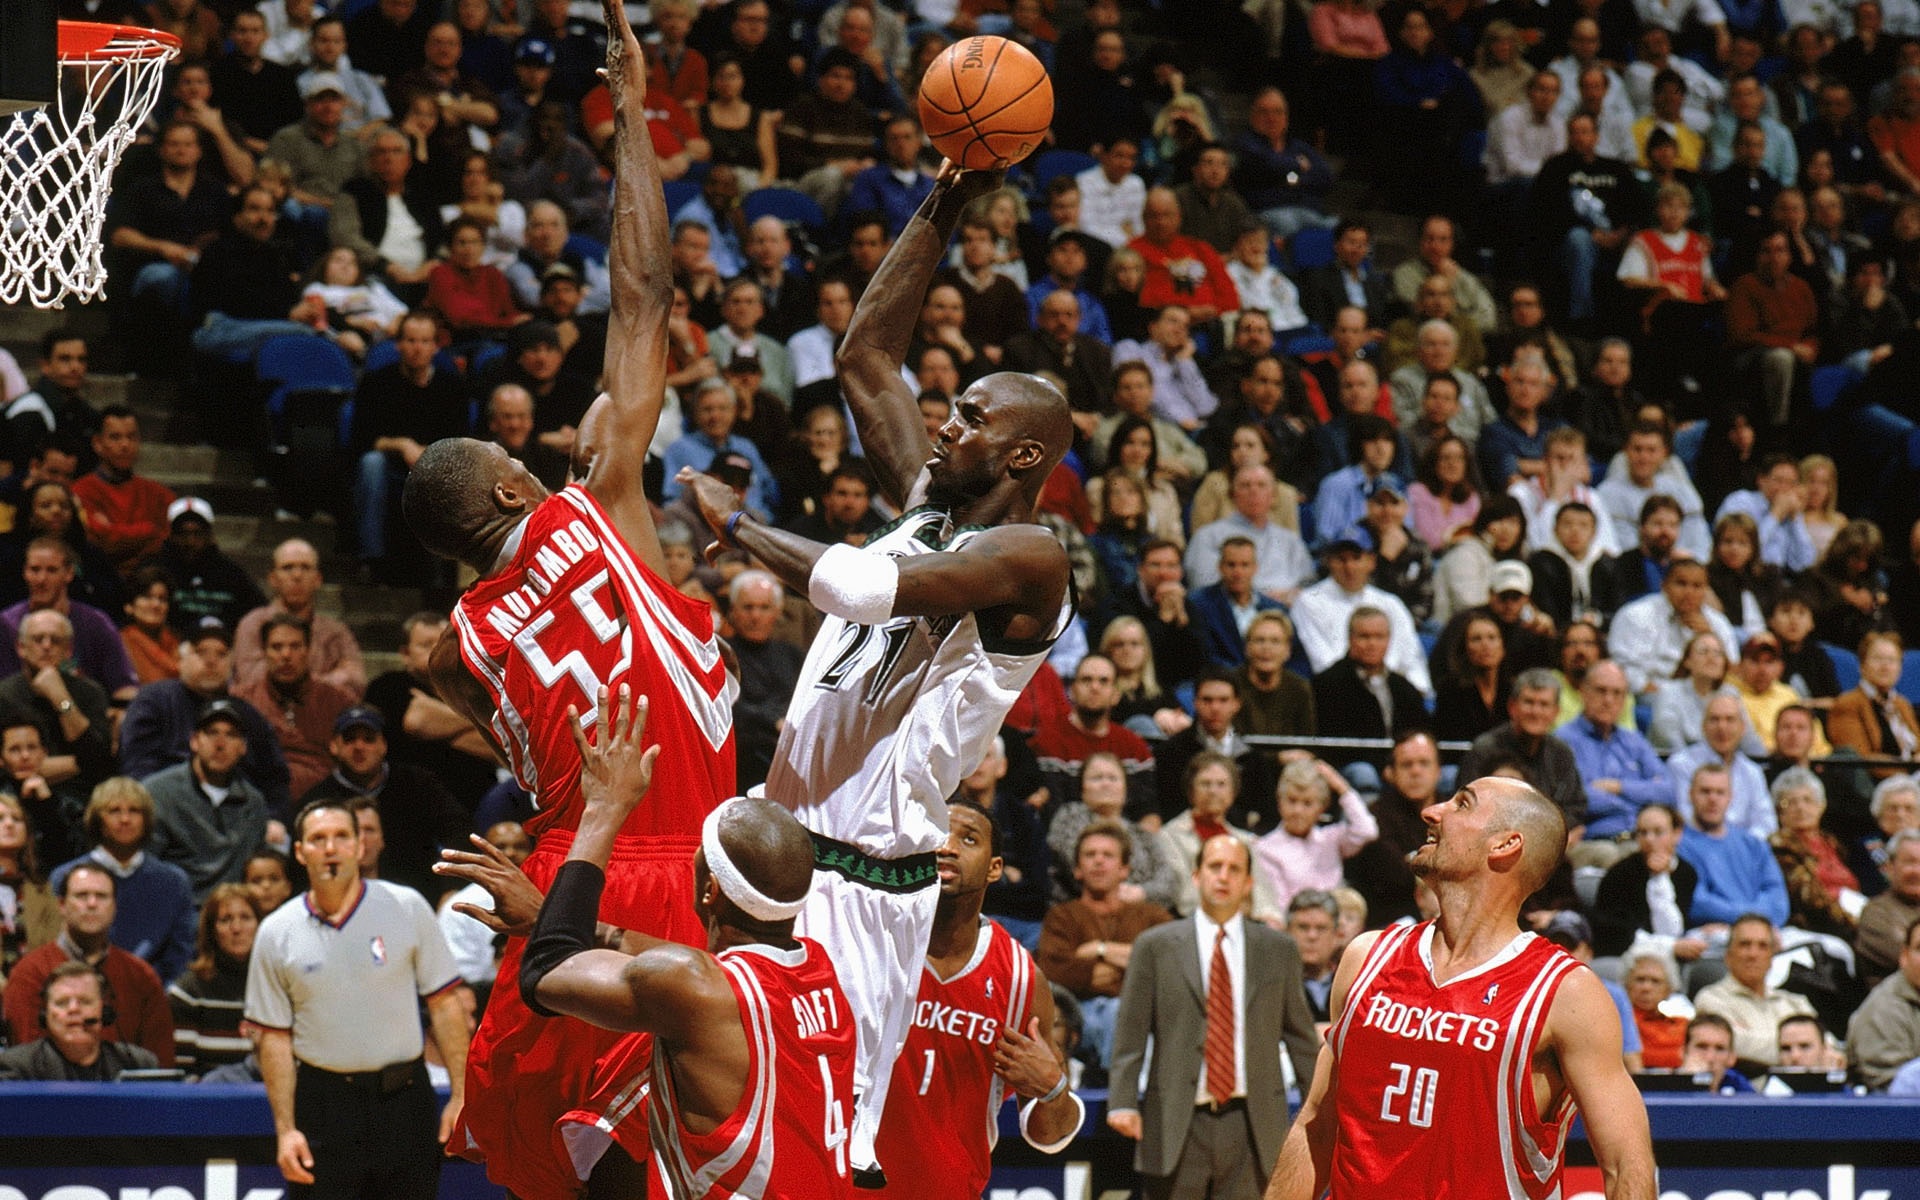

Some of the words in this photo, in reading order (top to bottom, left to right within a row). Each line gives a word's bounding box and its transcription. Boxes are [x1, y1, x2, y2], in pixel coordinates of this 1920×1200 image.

[486, 520, 600, 642] MUTOMBO
[814, 618, 918, 708] 21
[1363, 990, 1500, 1051] ROCKETS
[918, 1049, 936, 1096] 1
[1380, 1062, 1439, 1128] 20
[817, 1054, 848, 1178] 4
